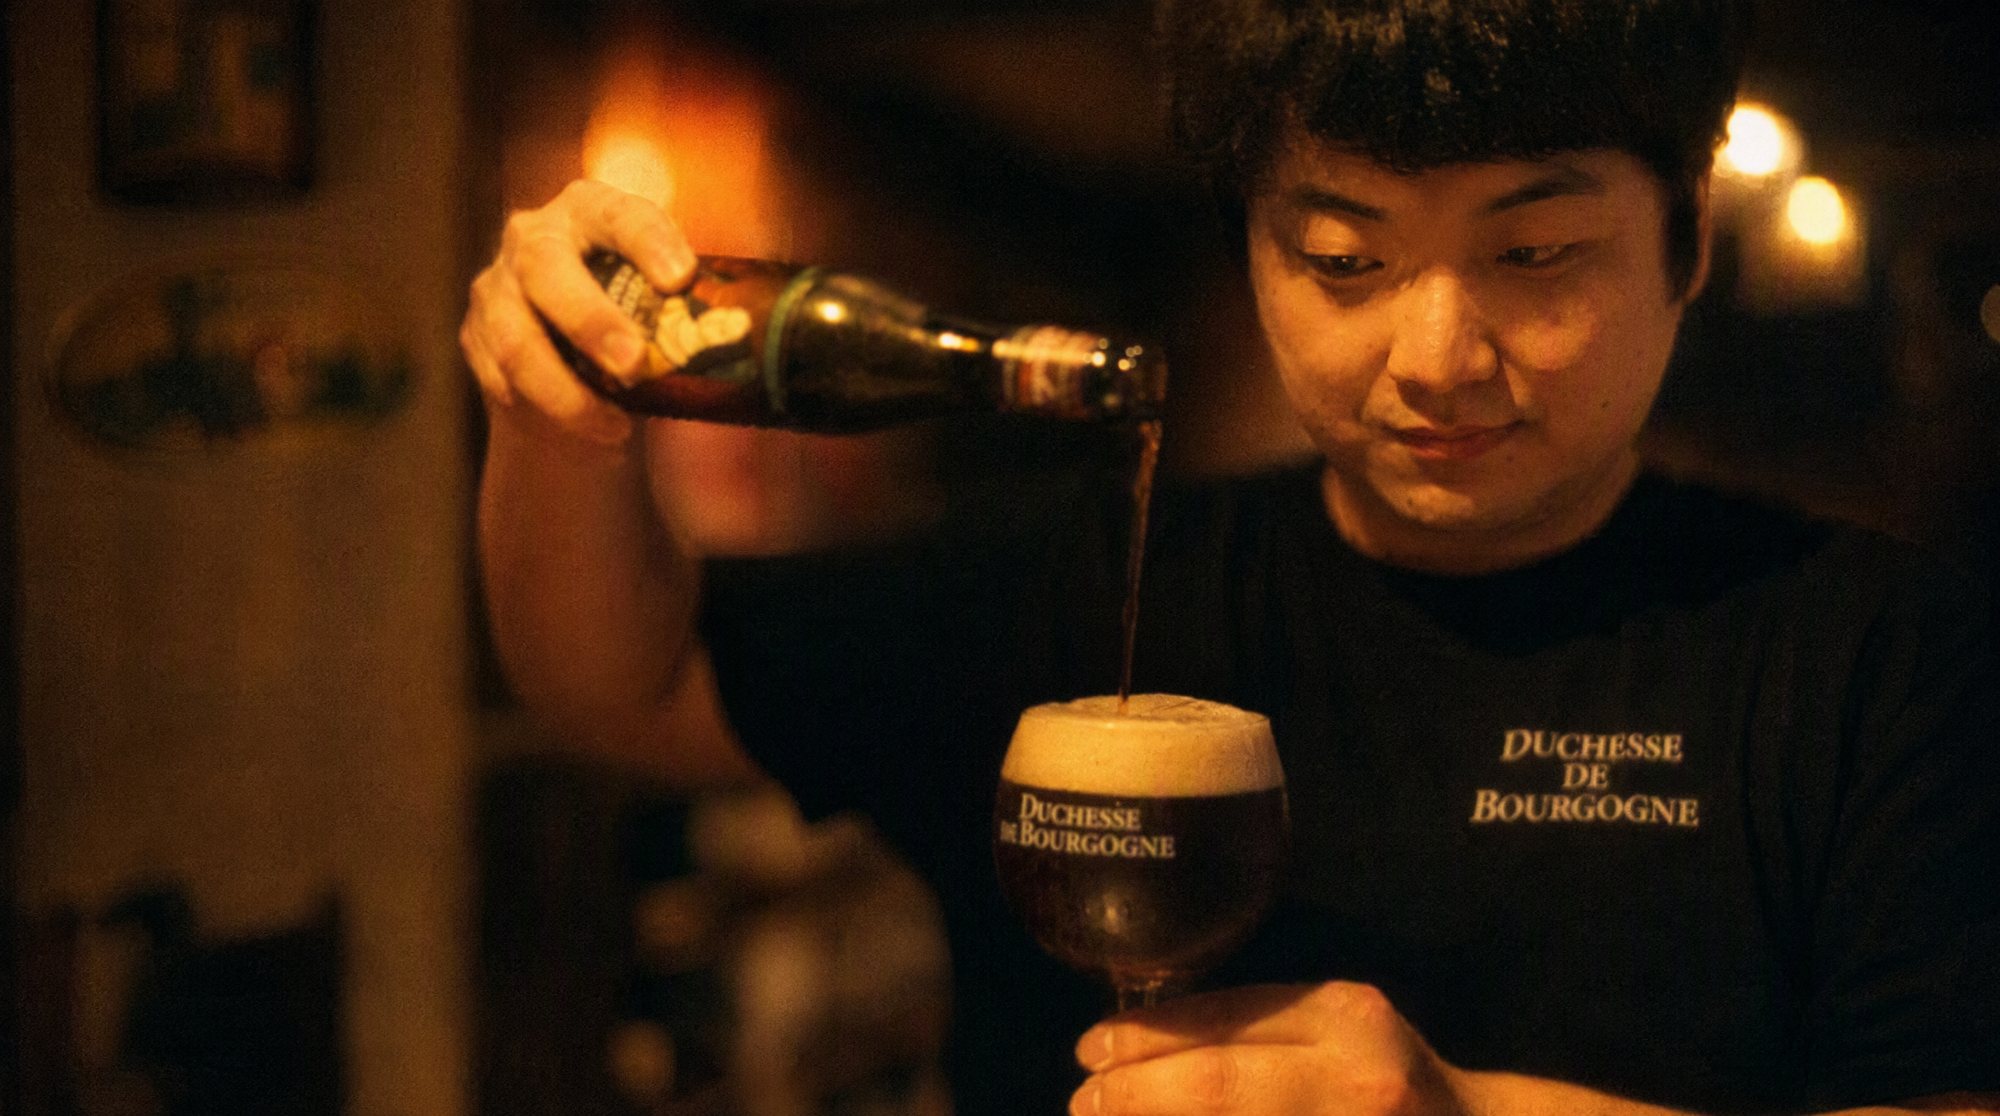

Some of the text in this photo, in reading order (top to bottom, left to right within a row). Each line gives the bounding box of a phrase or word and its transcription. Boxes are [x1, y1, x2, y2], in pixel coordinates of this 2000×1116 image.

[1501, 728, 1684, 764] DUCHESSE
[1562, 762, 1609, 790] DE
[1020, 792, 1142, 831] DUCHESSE
[1470, 788, 1700, 828] BOURGOGNE
[1020, 820, 1176, 859] BOURGOGNE
